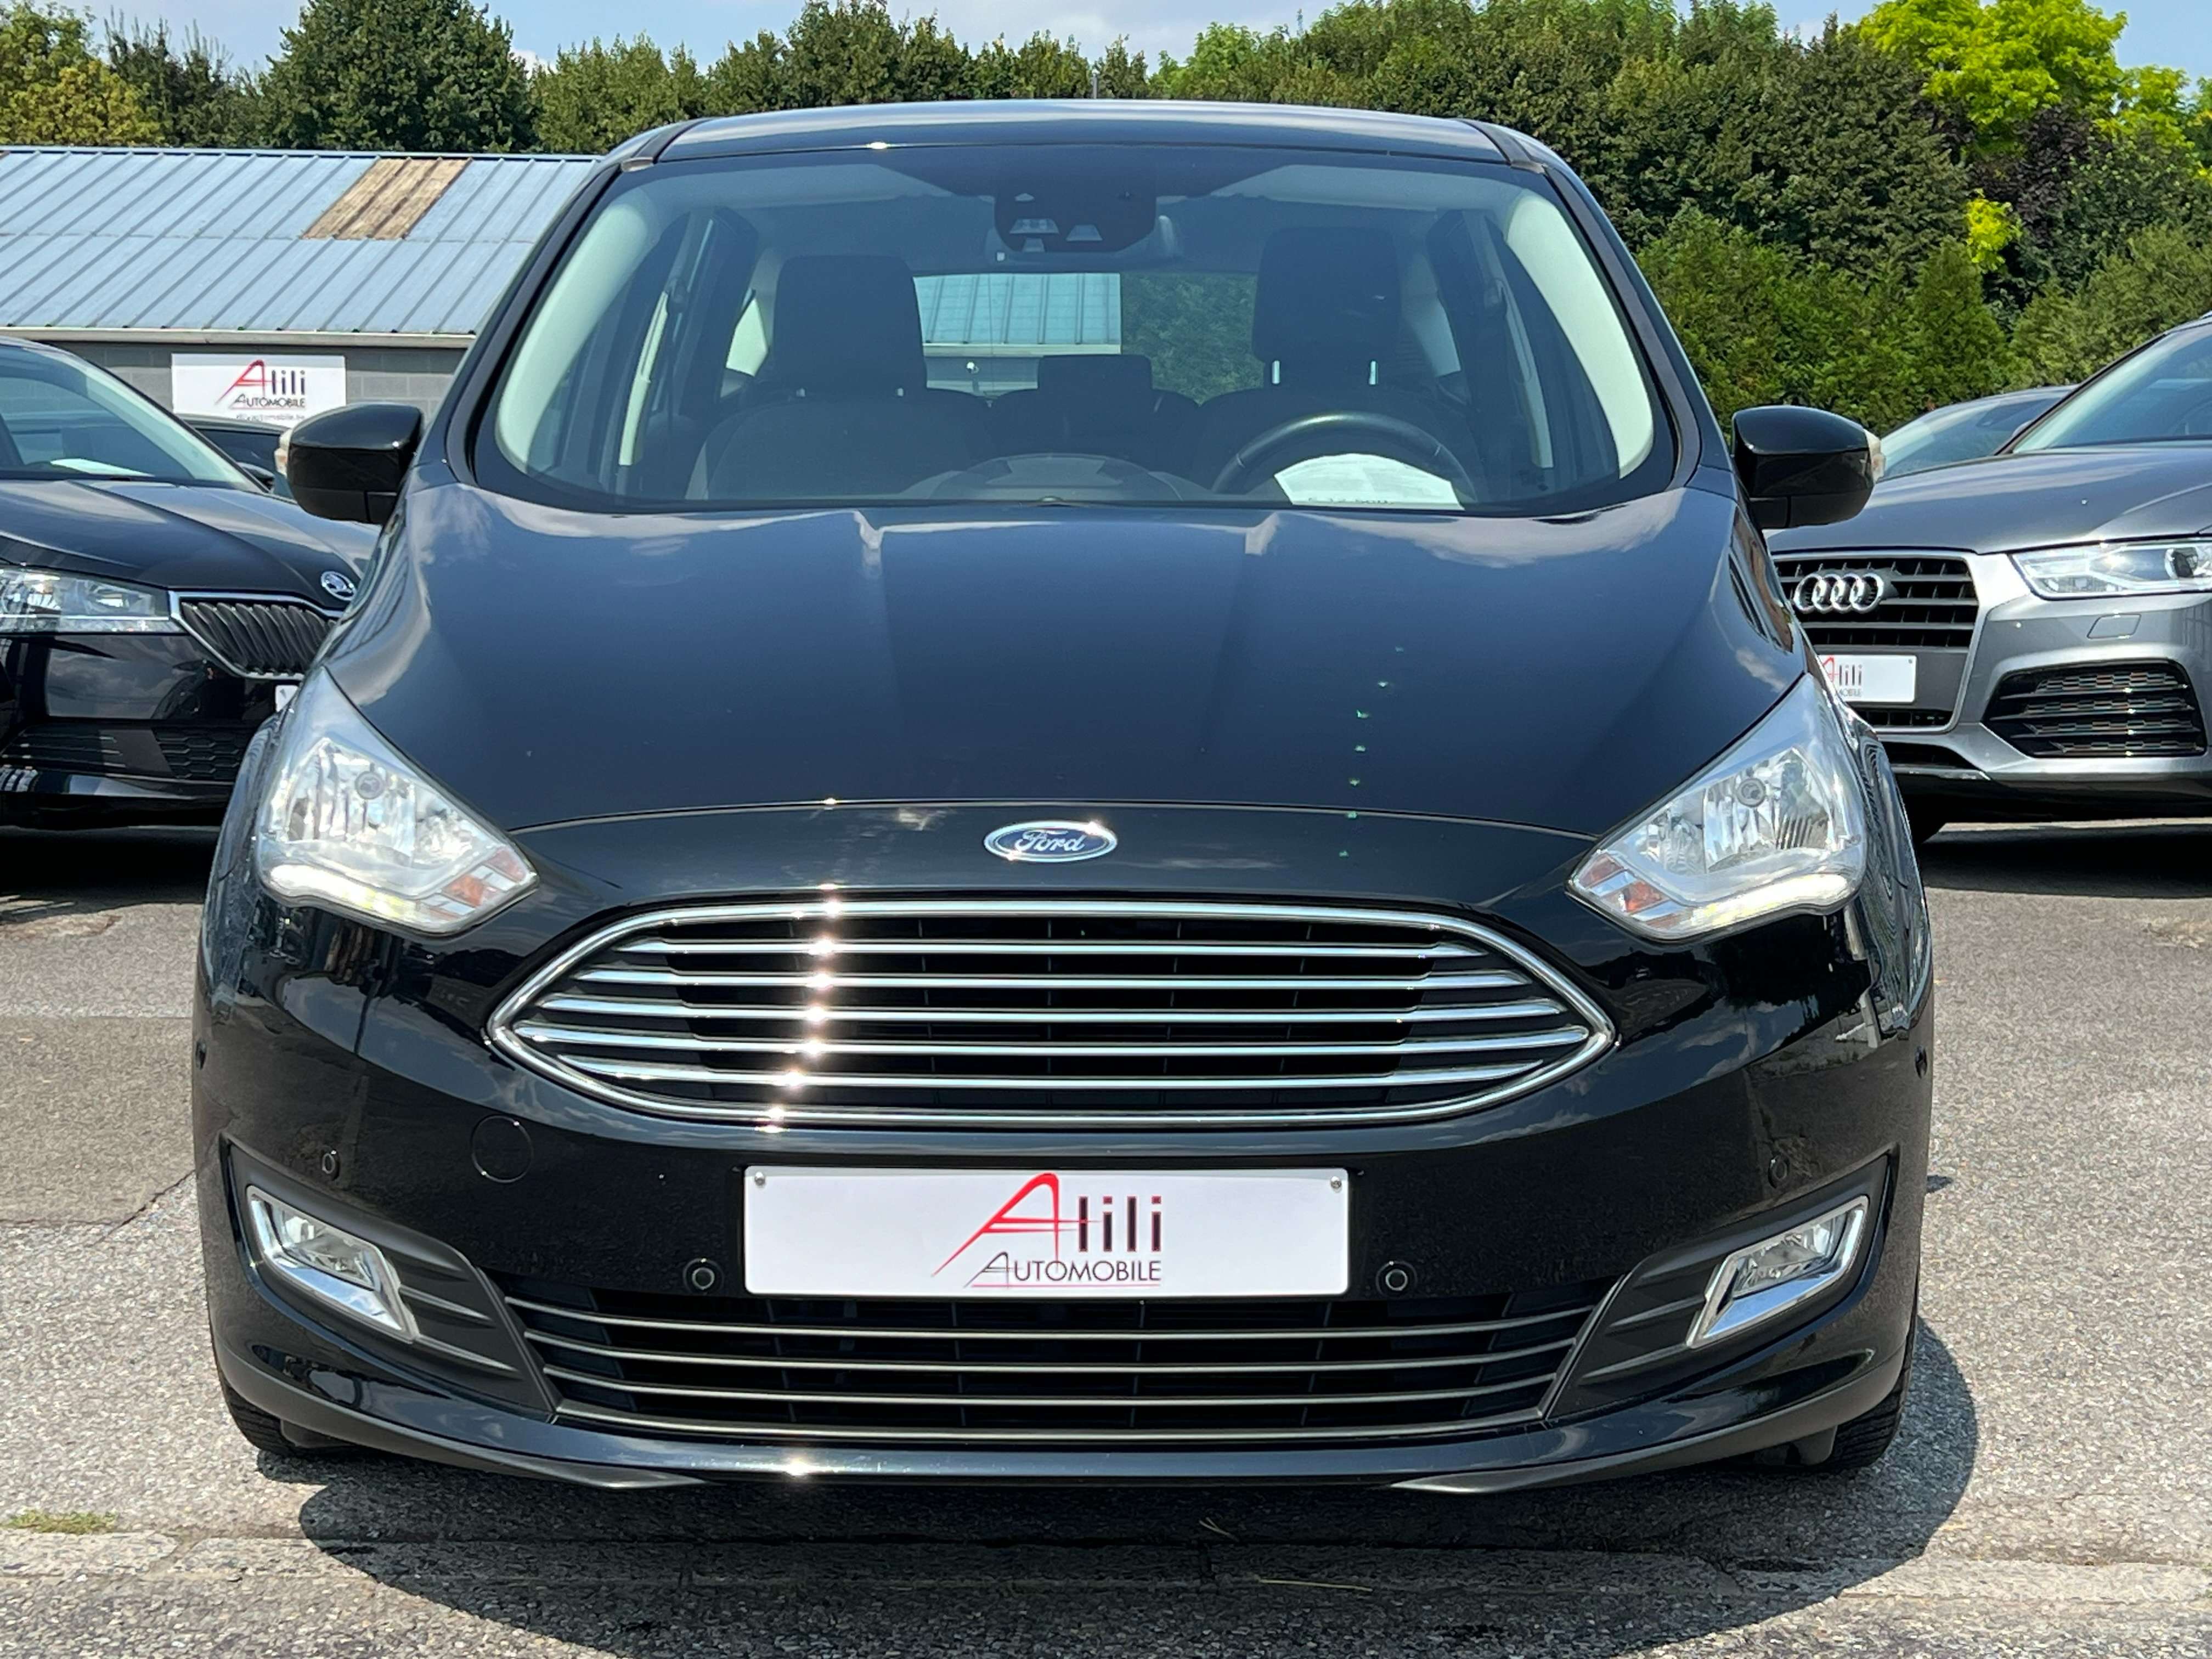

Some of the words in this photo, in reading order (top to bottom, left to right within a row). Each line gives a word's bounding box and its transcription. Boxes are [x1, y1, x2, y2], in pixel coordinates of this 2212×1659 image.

[215, 359, 306, 405] Alili
[229, 393, 306, 407] AUTOMOBILE
[1014, 829, 1087, 851] Ford
[931, 1172, 1163, 1277] Alili
[964, 1251, 1162, 1288] AUTOMOBILE
